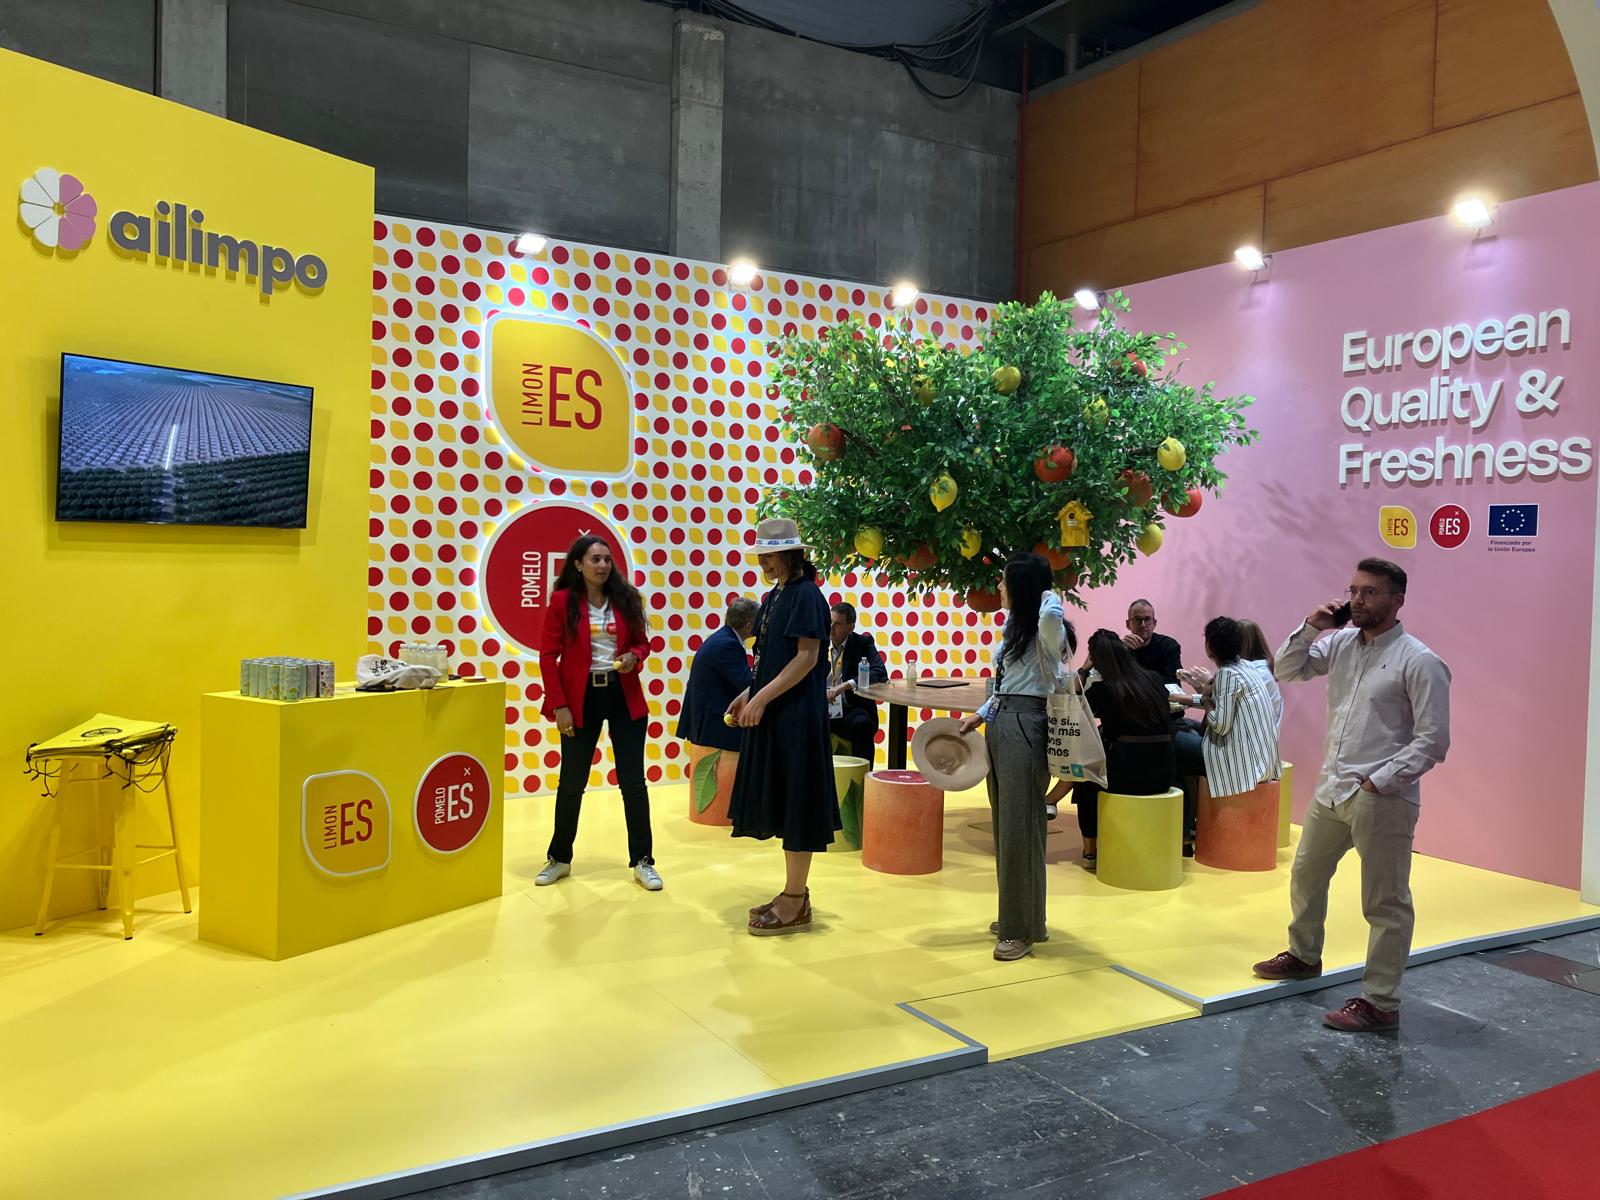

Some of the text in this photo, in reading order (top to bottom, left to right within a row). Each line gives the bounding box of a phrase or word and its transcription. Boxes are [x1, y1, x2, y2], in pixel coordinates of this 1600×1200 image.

[109, 200, 328, 294] ailimpo
[1343, 308, 1570, 371] European
[522, 363, 543, 426] LIMON
[549, 366, 602, 430] ES
[1341, 369, 1565, 431] Quality &
[1339, 436, 1593, 484] Freshness
[1394, 518, 1409, 536] ES
[1446, 518, 1461, 536] ES
[521, 551, 541, 608] POMELO
[1058, 726, 1081, 737] más
[340, 799, 373, 846] ES
[434, 787, 446, 825] POMELO
[447, 782, 474, 822] ES
[323, 804, 337, 849] LIMON
